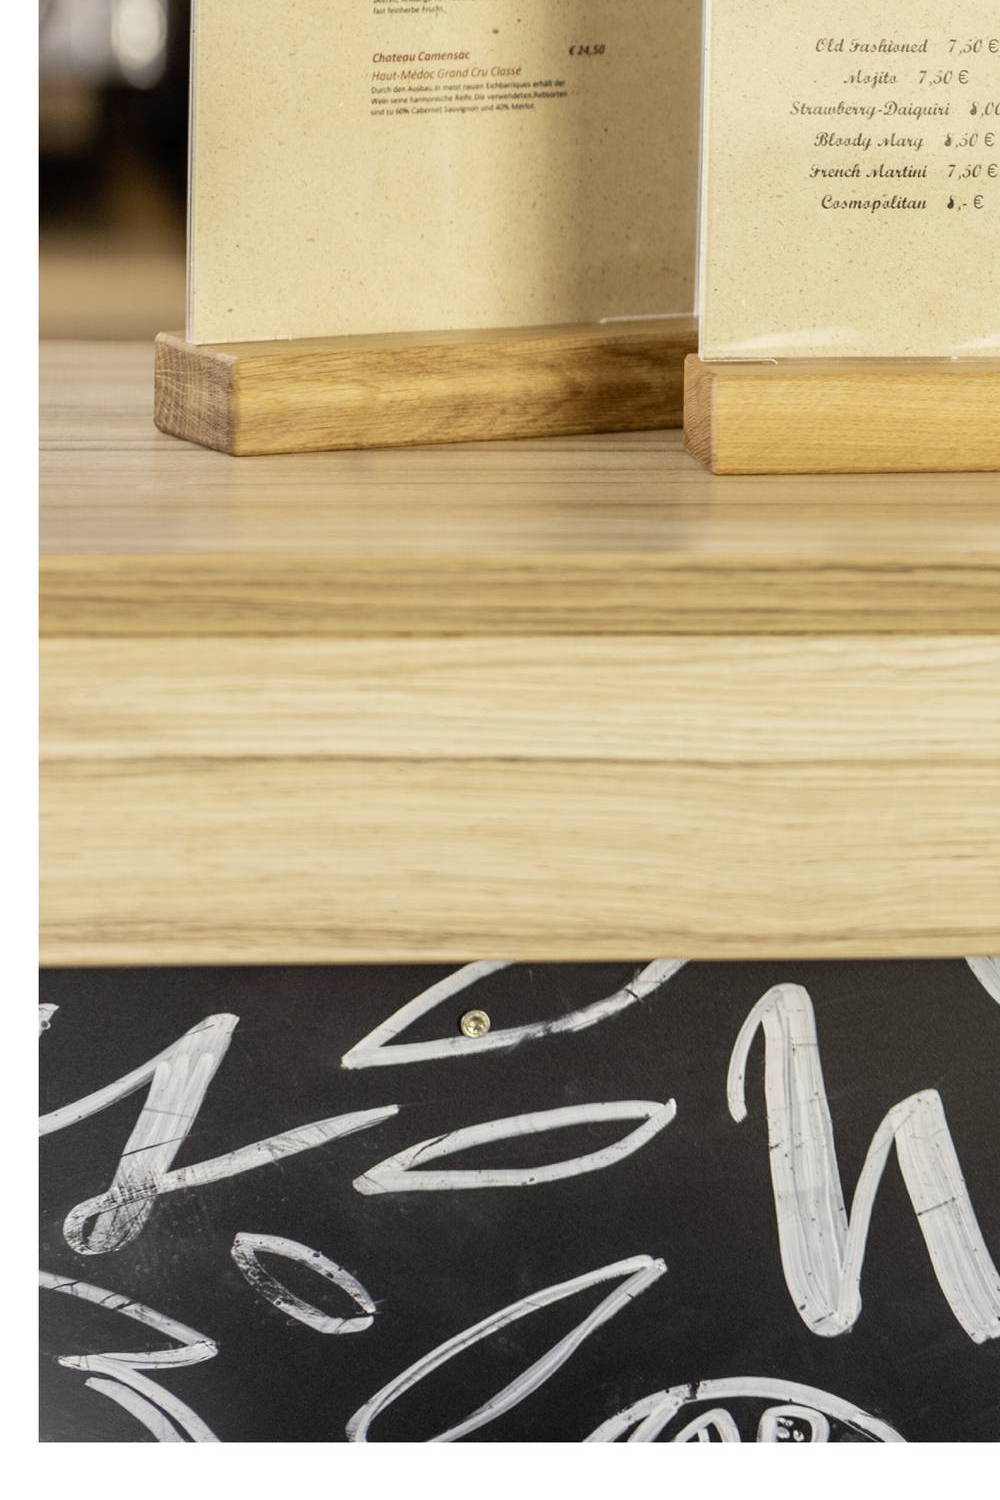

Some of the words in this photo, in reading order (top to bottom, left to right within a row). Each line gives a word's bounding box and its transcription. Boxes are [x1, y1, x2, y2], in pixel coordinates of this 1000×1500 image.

[814, 38, 844, 52] Old
[848, 38, 928, 52] Fashioned
[371, 51, 416, 63] Chateau
[416, 50, 470, 61] Camensac
[370, 69, 434, 81] Haut-Médoc
[436, 67, 469, 78] Grand
[470, 66, 488, 77] Cru
[489, 65, 522, 76] Classé
[843, 69, 897, 88] Mojito
[789, 100, 950, 119] Strawberry-Daiquiri
[813, 132, 872, 150] Bloody
[877, 132, 923, 150] Mary
[808, 163, 861, 177] French
[865, 164, 927, 178] Martini
[820, 195, 927, 213] Cosmopolitan
